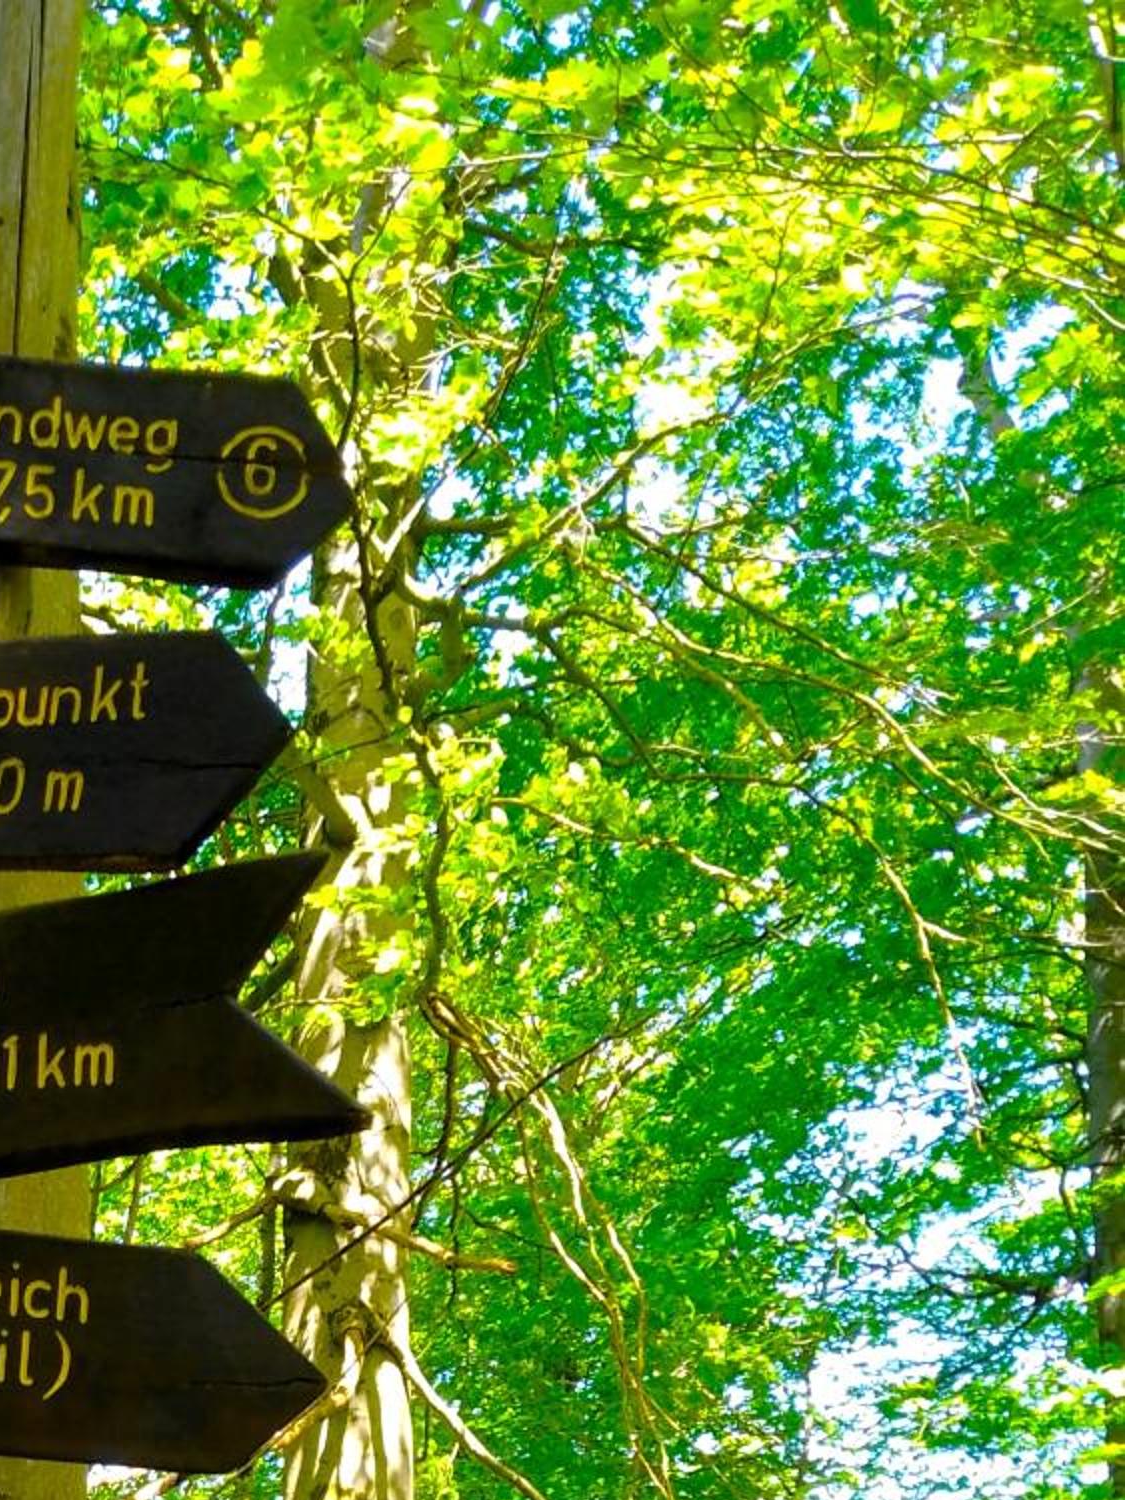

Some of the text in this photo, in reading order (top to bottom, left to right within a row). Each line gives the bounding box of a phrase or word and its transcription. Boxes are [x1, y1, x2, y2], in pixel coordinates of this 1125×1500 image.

[244, 436, 276, 495] 6
[72, 464, 155, 528] km
[42, 771, 86, 811] m
[2, 1035, 18, 1088] 1
[36, 1032, 115, 1088] km
